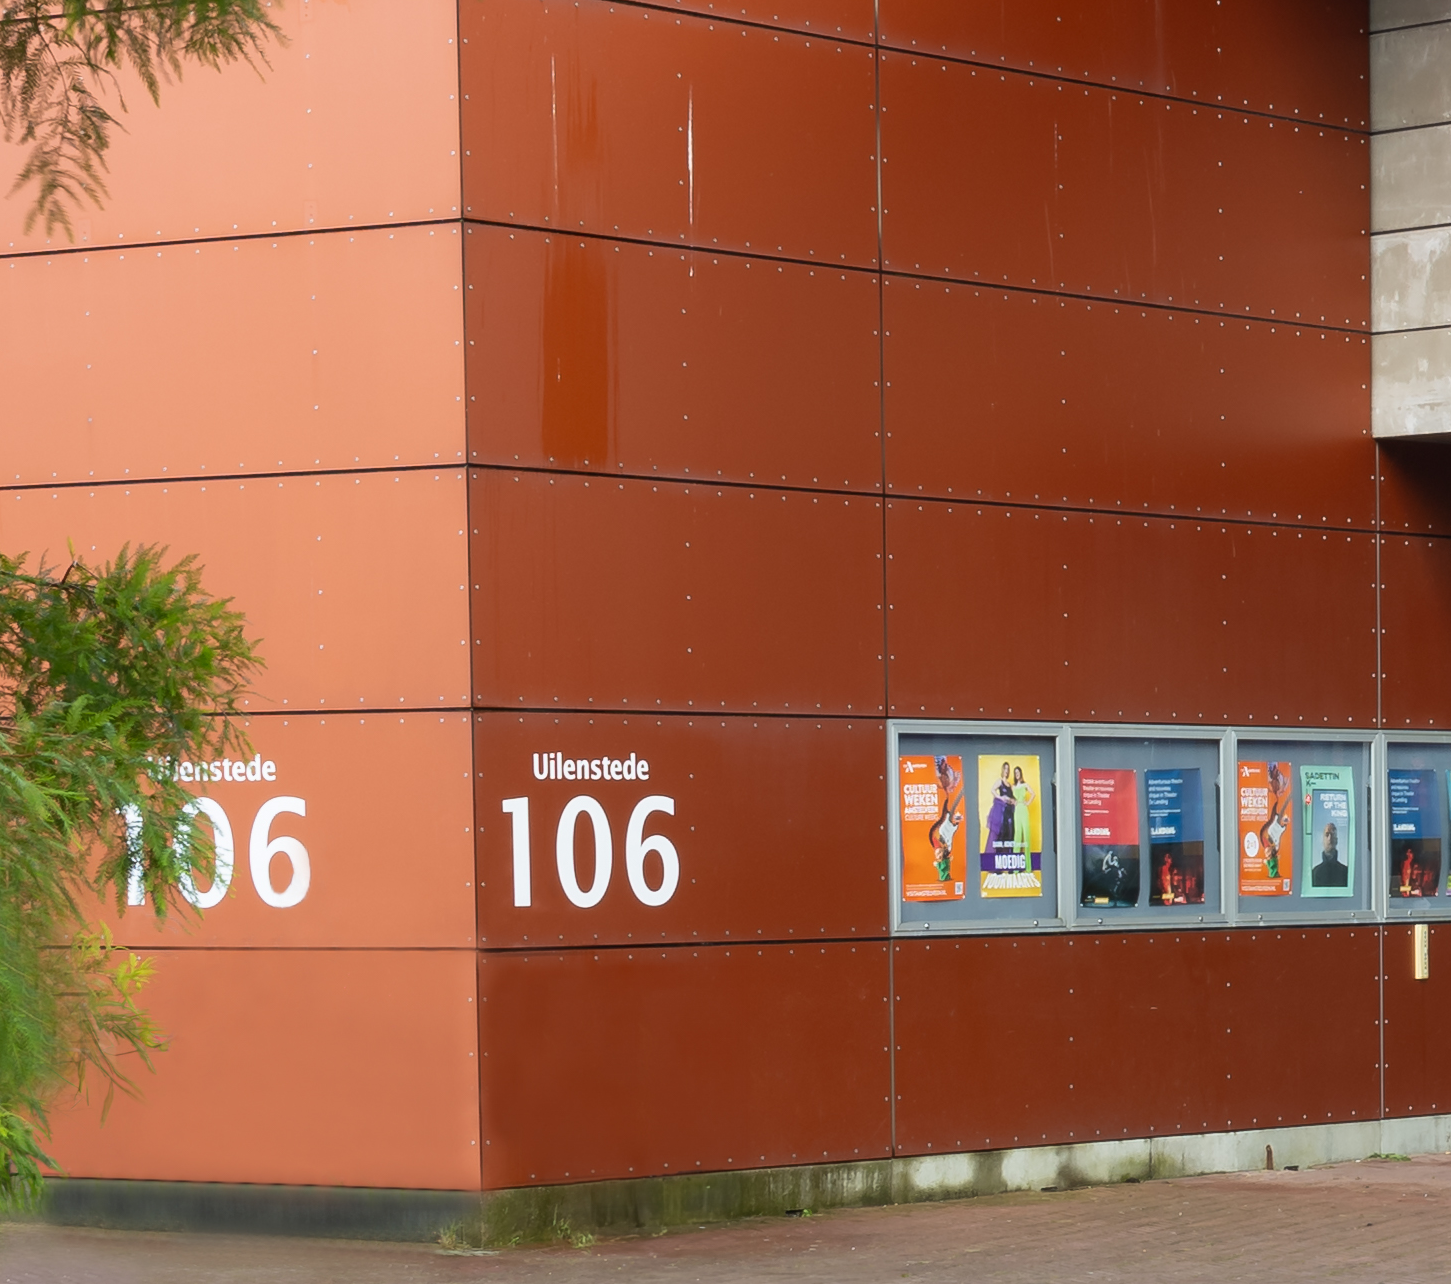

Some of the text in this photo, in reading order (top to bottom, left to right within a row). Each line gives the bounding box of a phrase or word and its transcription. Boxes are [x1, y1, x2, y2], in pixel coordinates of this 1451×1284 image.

[533, 752, 650, 780] Uilenstede
[1305, 772, 1340, 780] SADETTIN
[903, 784, 938, 794] CULTUUR
[904, 794, 938, 805] WEKEN
[117, 796, 311, 909] 106
[502, 795, 680, 909] 106
[995, 854, 1026, 869] MOEDIG
